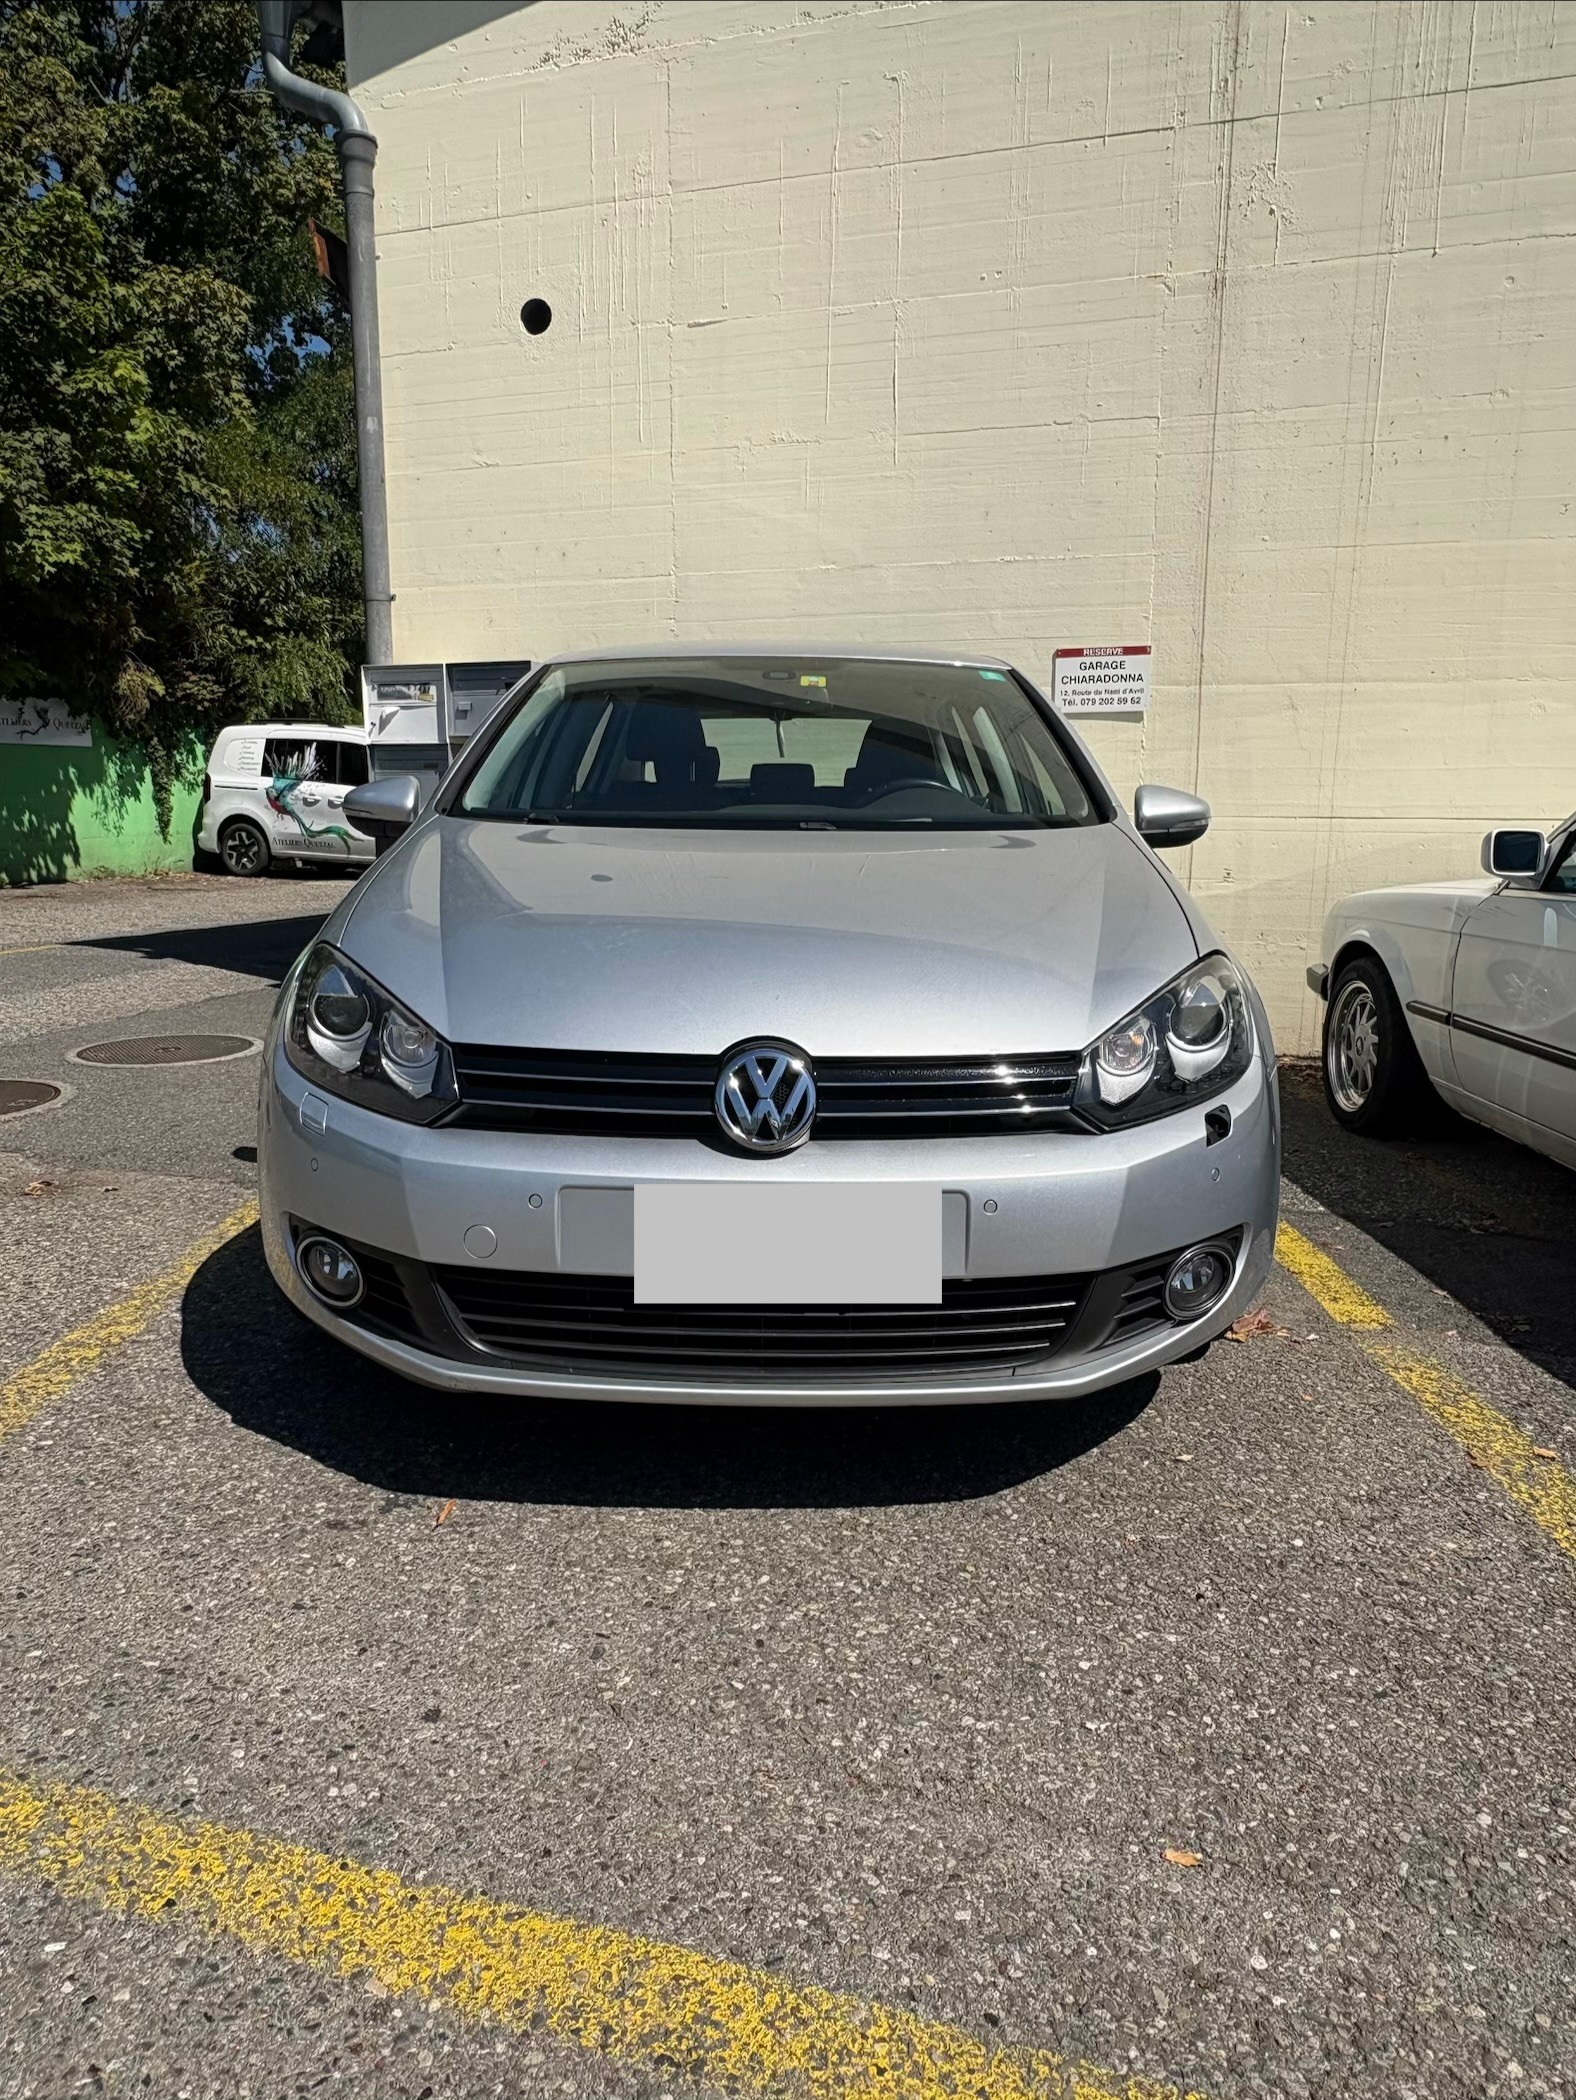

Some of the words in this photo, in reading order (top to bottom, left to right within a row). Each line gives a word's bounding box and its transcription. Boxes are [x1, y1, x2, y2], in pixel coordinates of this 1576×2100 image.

[1079, 660, 1127, 671] GARAGE
[1061, 673, 1144, 685] CHIARADONNA
[1080, 698, 1097, 706] 079
[1098, 697, 1115, 706] 202
[1116, 697, 1128, 705] 59
[1130, 696, 1141, 705] 62
